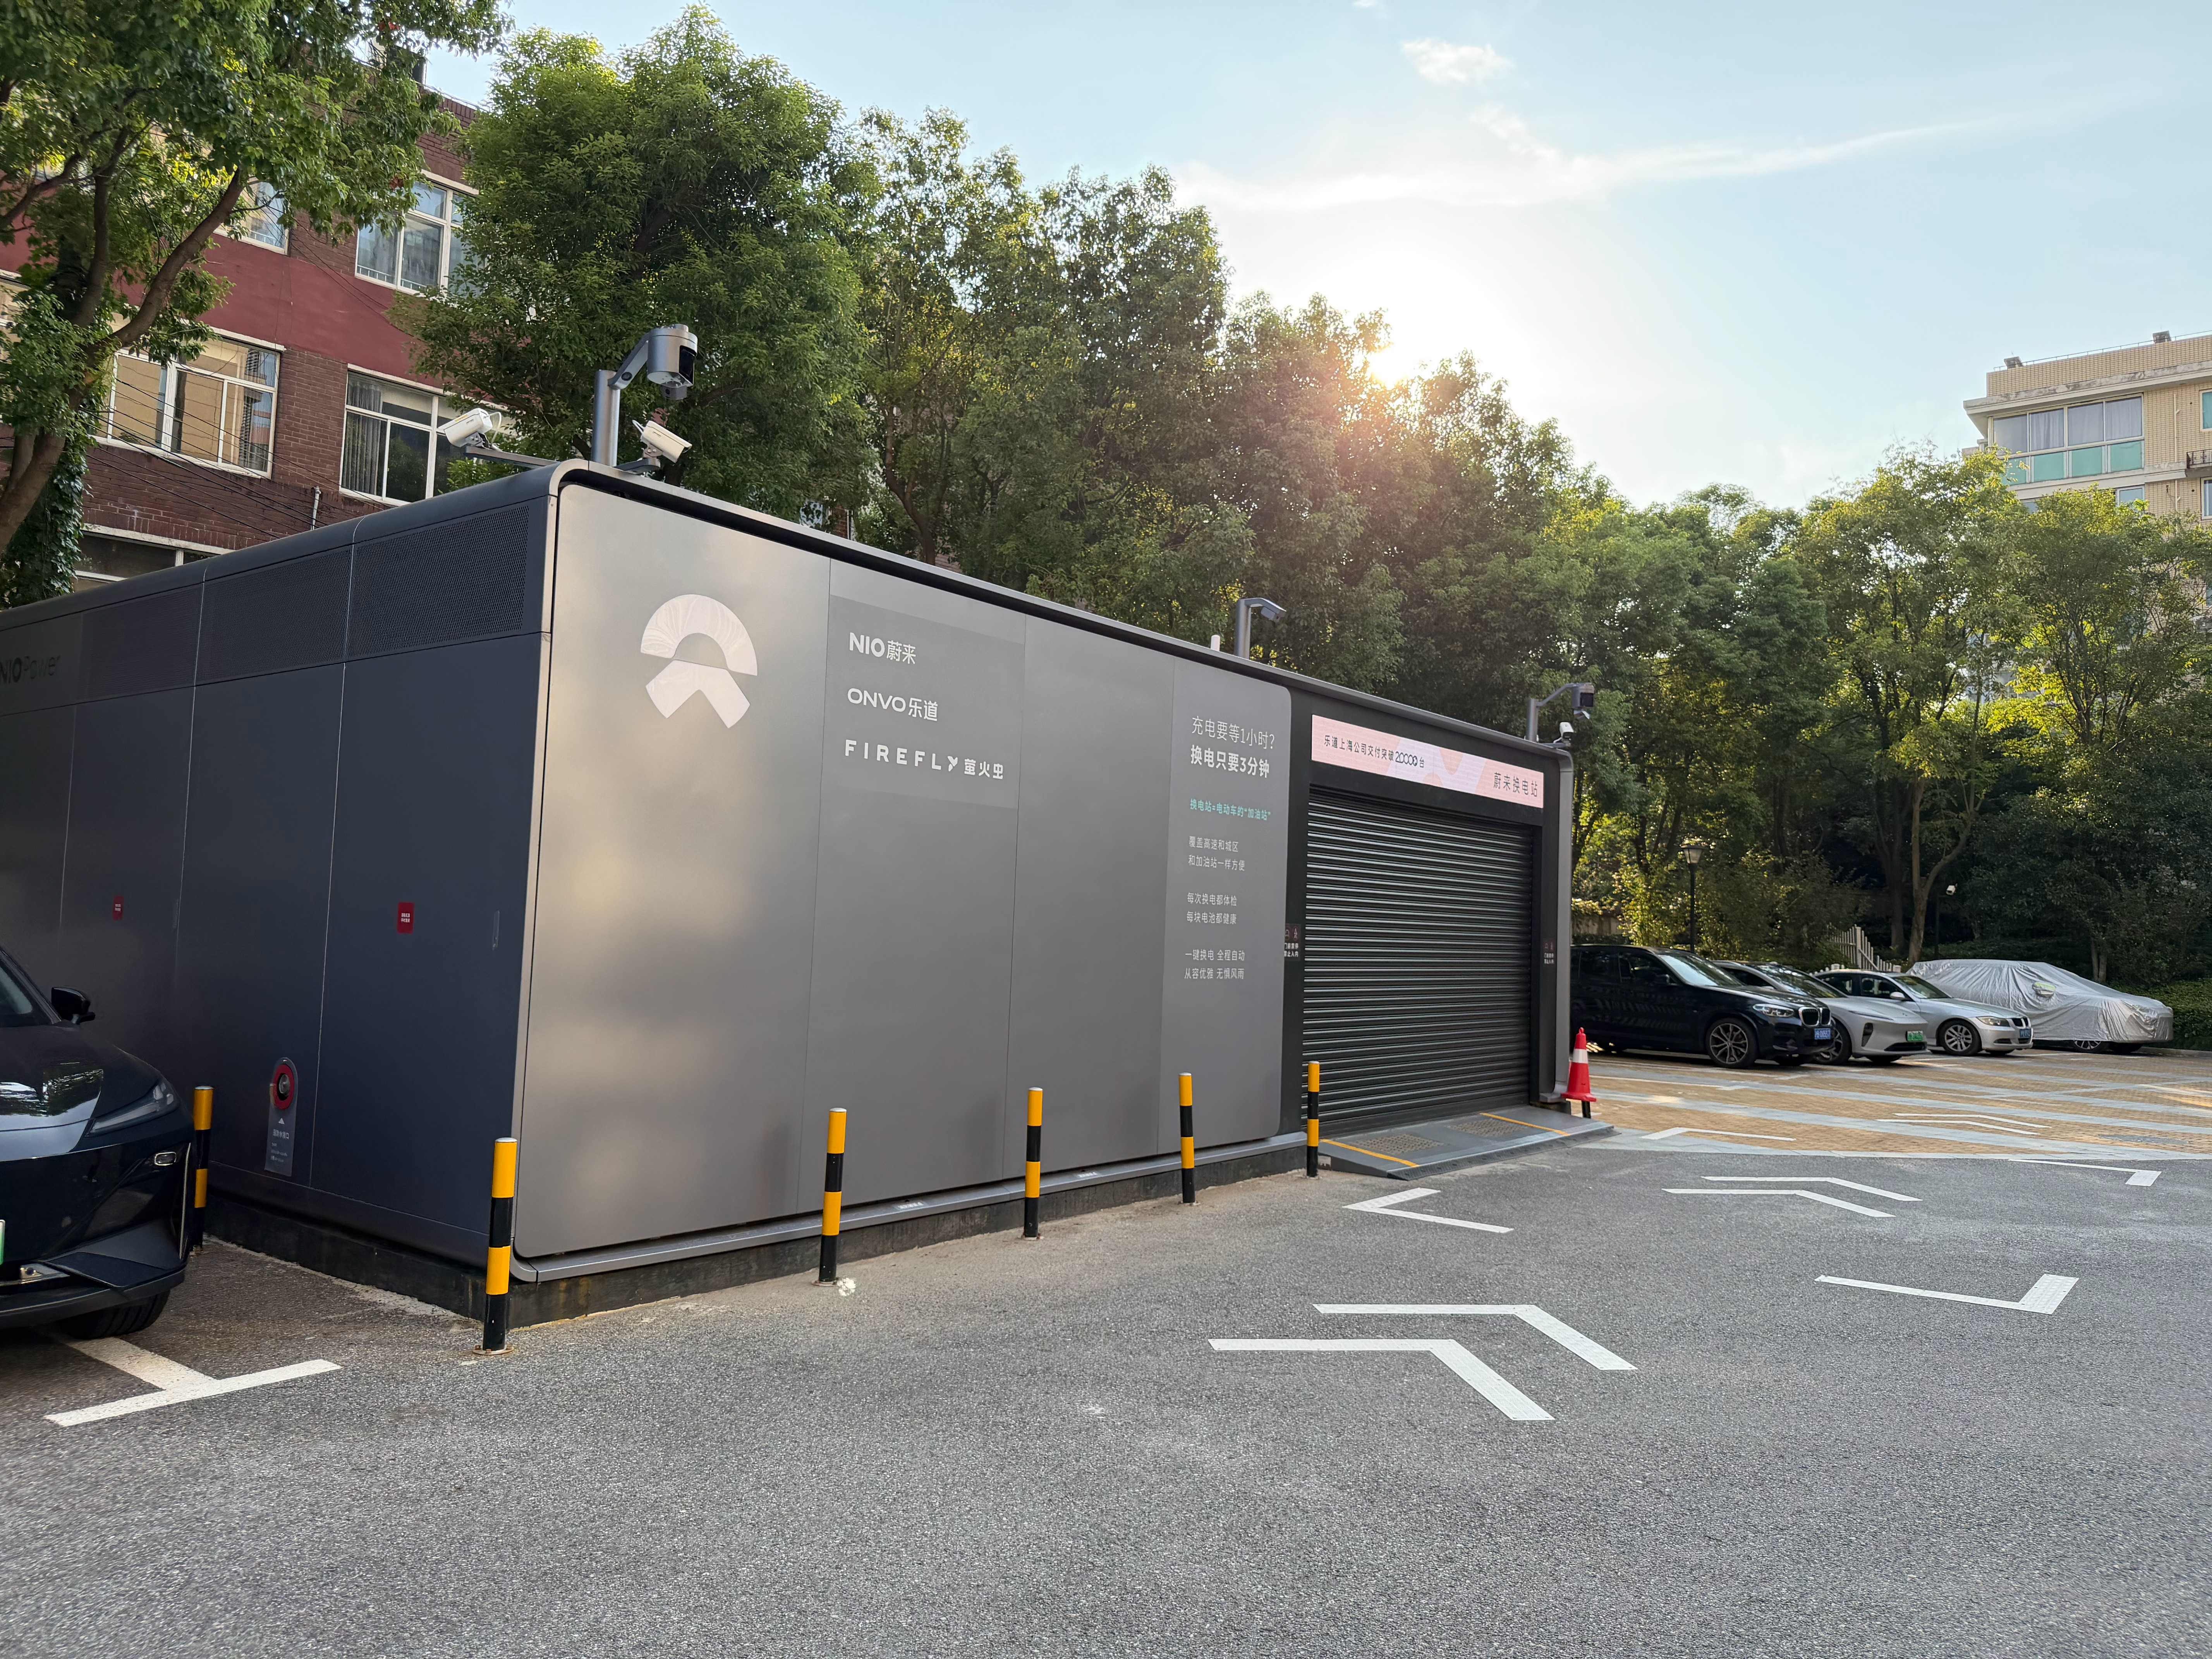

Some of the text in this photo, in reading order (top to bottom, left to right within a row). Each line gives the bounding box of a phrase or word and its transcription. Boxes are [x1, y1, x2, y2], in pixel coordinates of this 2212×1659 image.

[1190, 744, 1269, 778] 换电只要3分钟
[1493, 772, 1538, 797] 蔚来换电站
[1189, 836, 1238, 852] 覆盖高速和城区
[1188, 855, 1245, 871] 和加油站一样方便
[1187, 892, 1237, 906] 每次换电都体检
[1186, 911, 1237, 924] 每块电池都健康
[1185, 949, 1245, 961] 一键换电 全程自动
[1184, 968, 1245, 979] 从容优雅 无惧风雨
